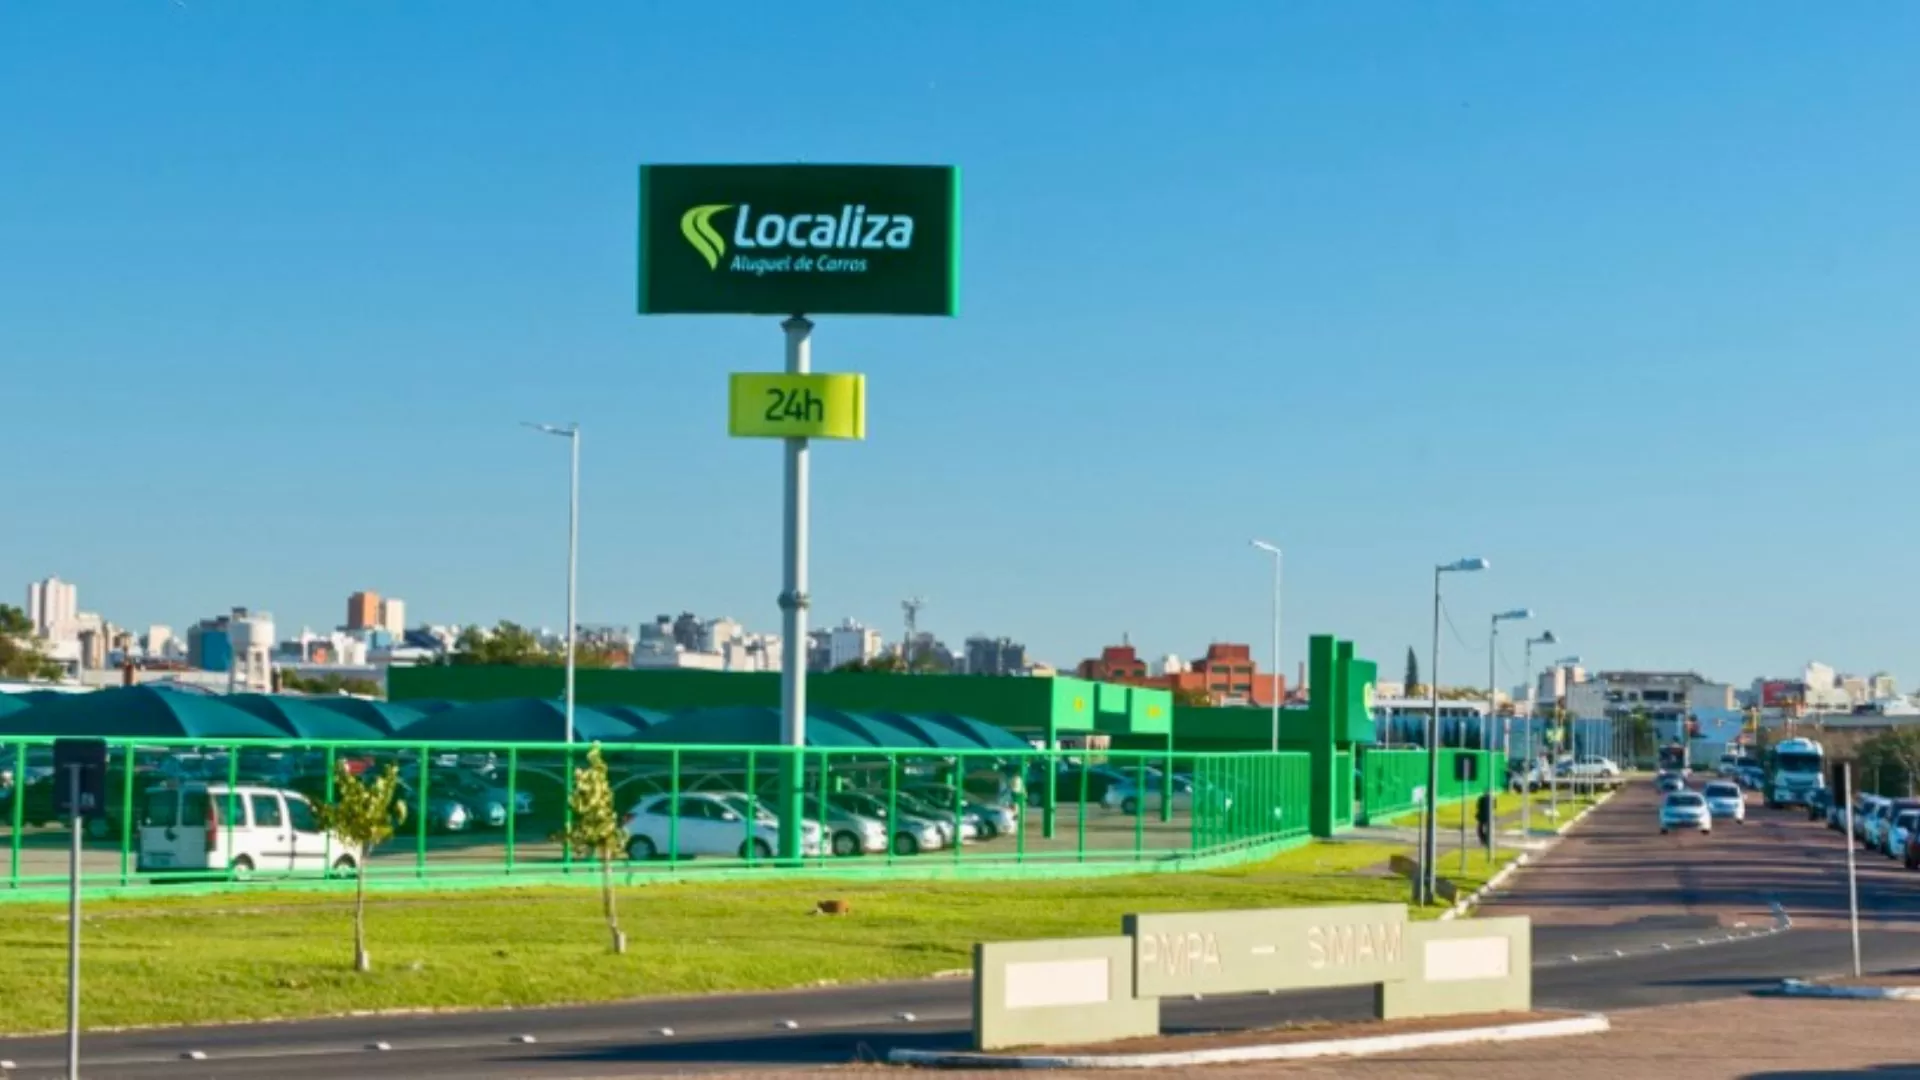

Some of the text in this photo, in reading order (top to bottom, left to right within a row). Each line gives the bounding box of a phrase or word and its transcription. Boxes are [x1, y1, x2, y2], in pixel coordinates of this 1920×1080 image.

[734, 204, 914, 249] Localiza
[730, 254, 867, 276] Aluguel de Carros
[764, 388, 824, 422] 24h
[1140, 931, 1223, 977] PMPA
[1306, 922, 1405, 969] SMAM
